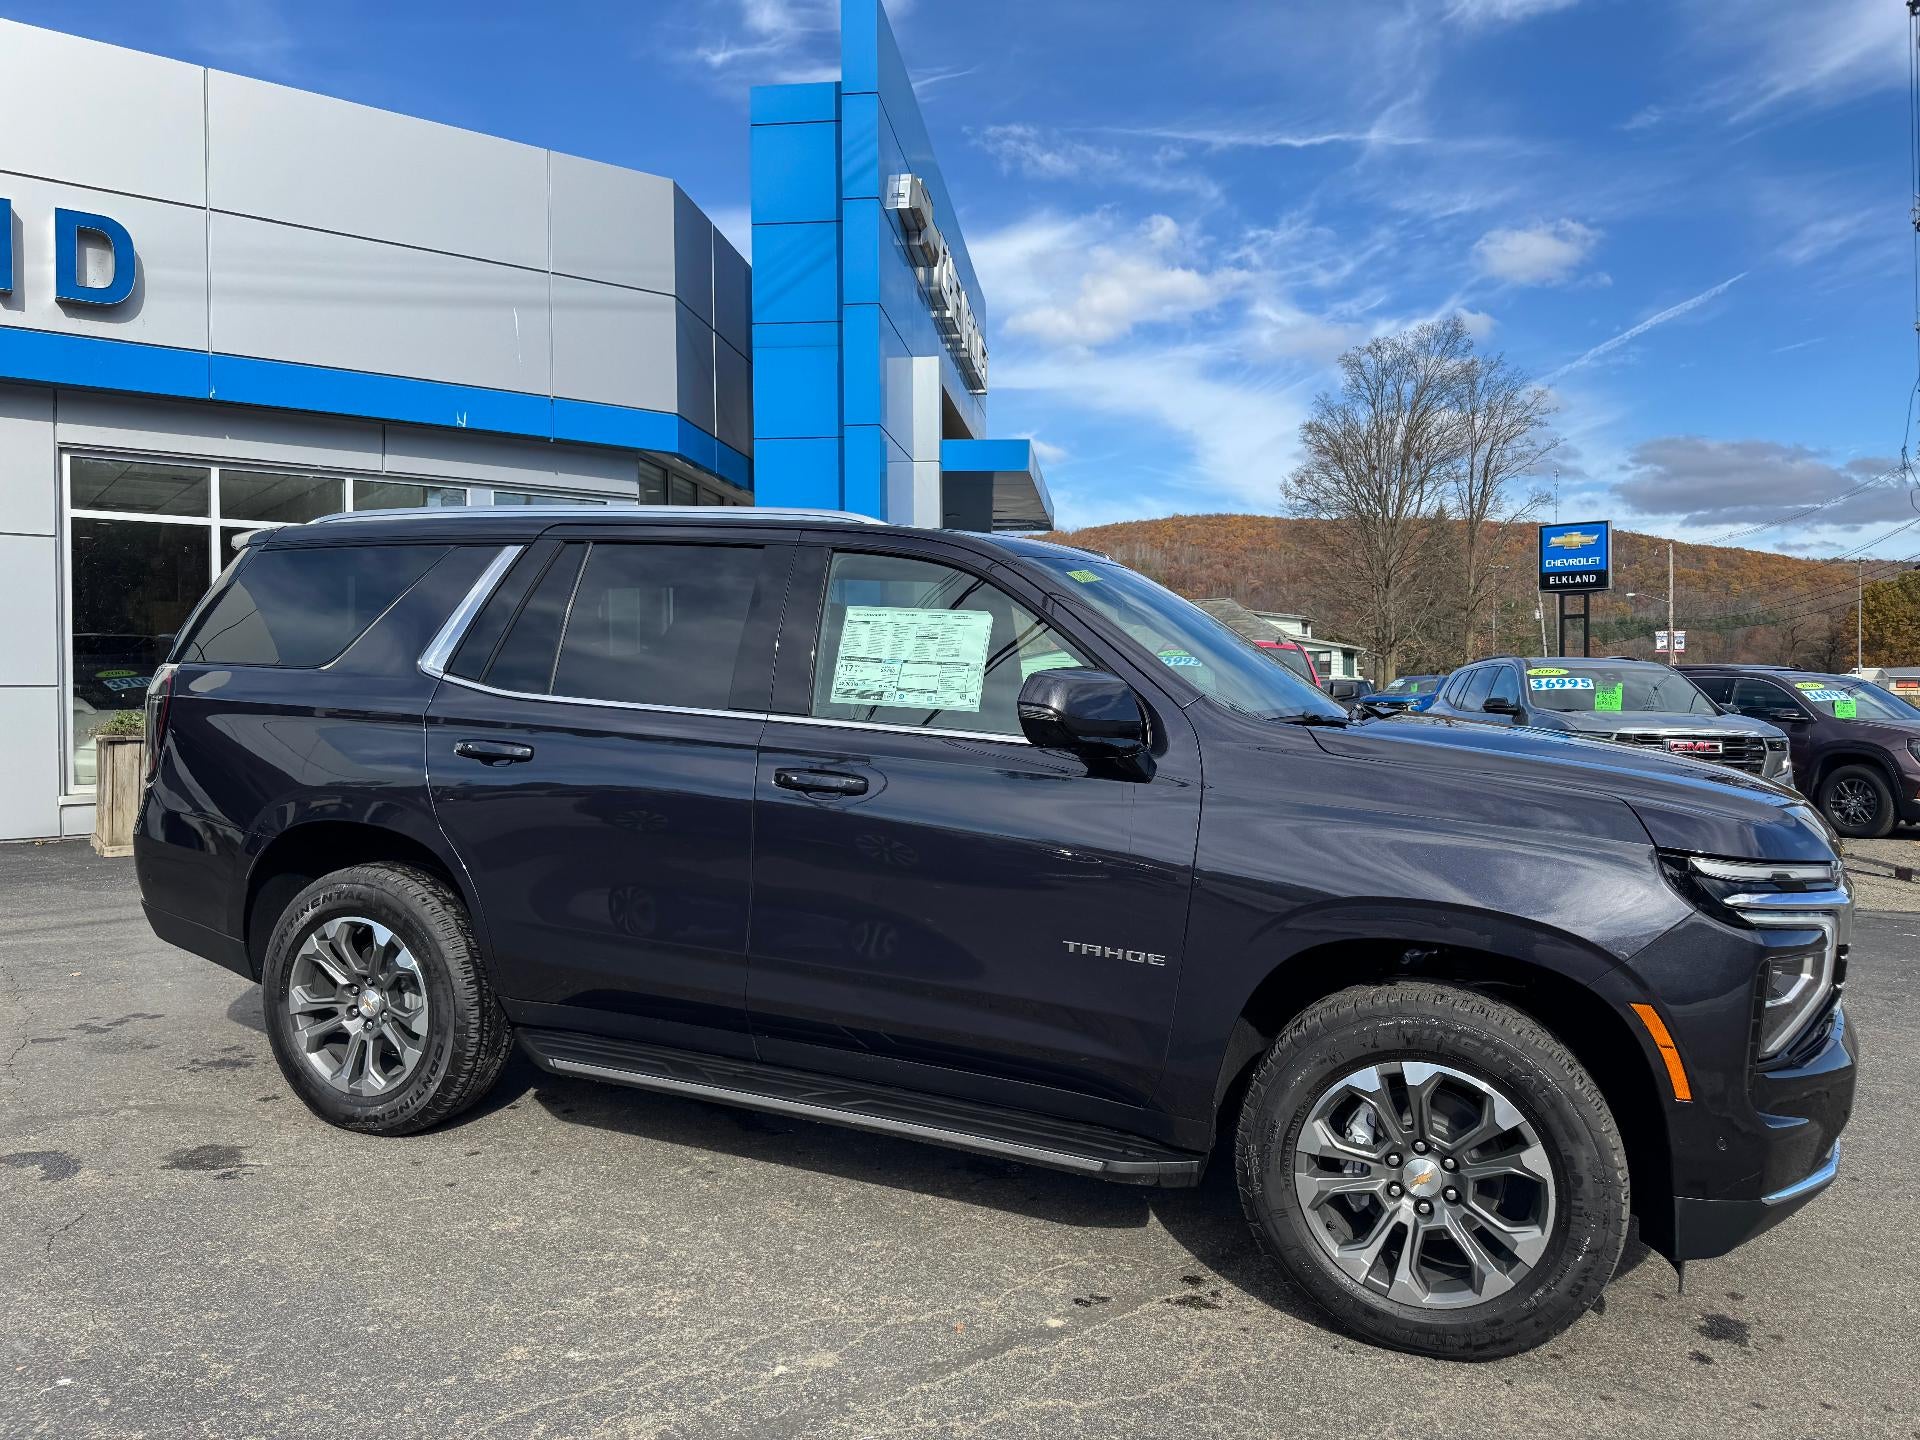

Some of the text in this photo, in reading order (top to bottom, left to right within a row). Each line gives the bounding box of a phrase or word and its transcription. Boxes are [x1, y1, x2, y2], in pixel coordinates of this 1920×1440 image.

[1545, 556, 1600, 567] CHEVROLET
[1549, 574, 1597, 585] ELKLAND
[1532, 678, 1591, 690] 36995
[1669, 740, 1722, 753] GMC
[1062, 940, 1167, 966] TAHOE
